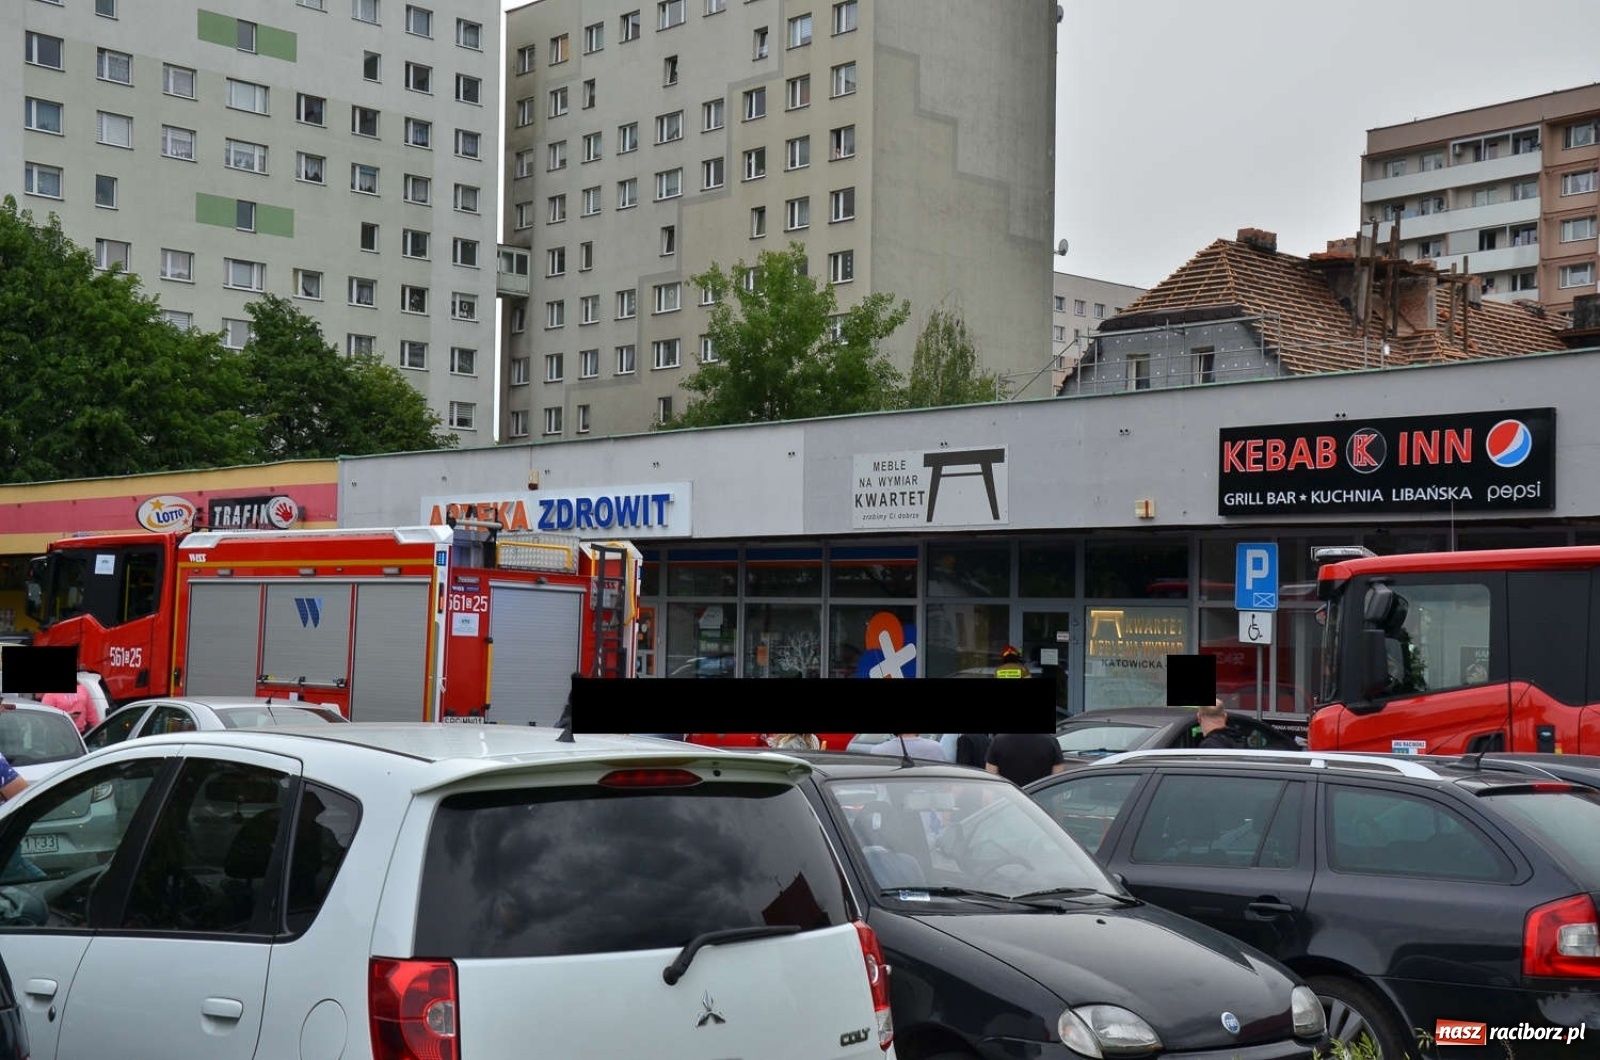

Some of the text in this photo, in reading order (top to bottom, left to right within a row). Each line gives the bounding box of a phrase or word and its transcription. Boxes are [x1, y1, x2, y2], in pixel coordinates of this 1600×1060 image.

[1223, 435, 1338, 473] KEBAB
[1398, 428, 1473, 466] INN
[873, 460, 907, 472] MEBLE
[859, 474, 918, 488] NA WYMIAR
[1487, 481, 1541, 502] pepsi
[854, 490, 925, 508] KWARTET
[1223, 484, 1473, 506] GRILL BAR KUCHNIA LIBAŃSKA
[155, 507, 184, 524] LOTTO
[213, 503, 270, 529] TRAFIK
[537, 493, 672, 531] ZDROWIT
[1245, 549, 1269, 590] P
[1101, 658, 1164, 669] KATOWICKA
